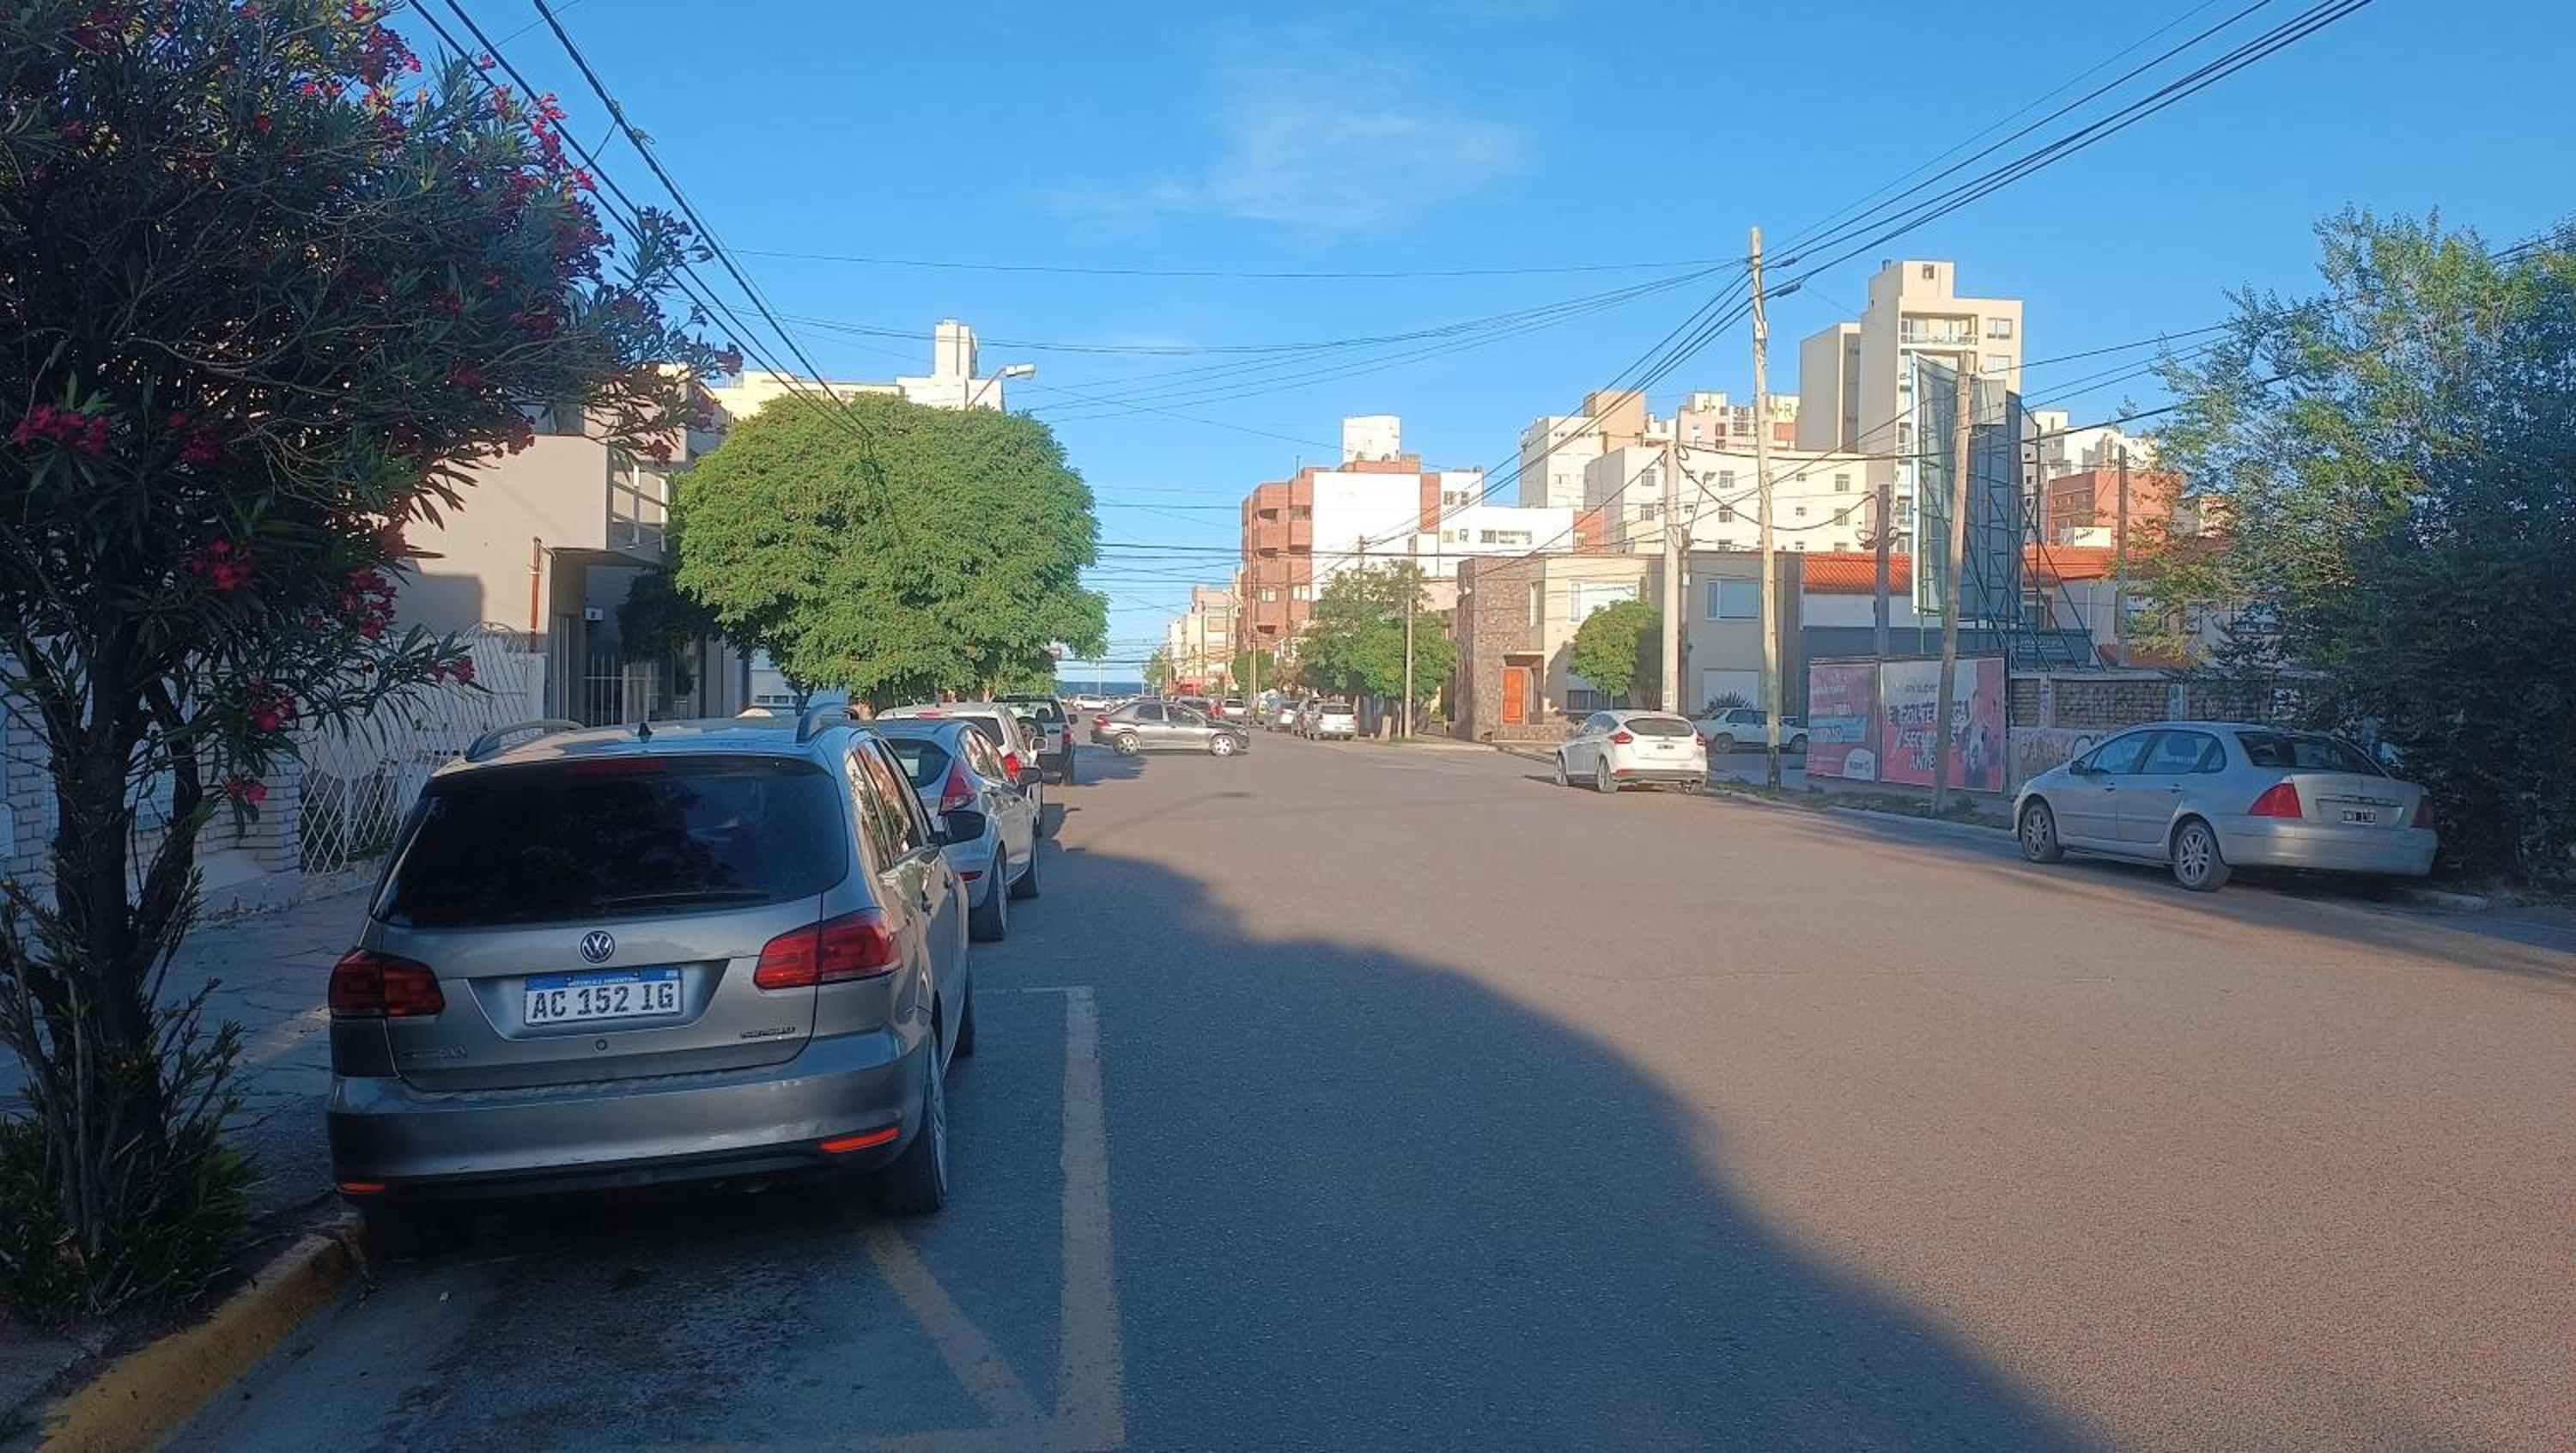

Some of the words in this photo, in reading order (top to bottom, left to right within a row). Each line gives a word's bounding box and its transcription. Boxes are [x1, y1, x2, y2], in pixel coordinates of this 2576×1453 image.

[532, 990, 567, 1020] AC
[577, 985, 630, 1016] 152
[640, 982, 675, 1012] IG
